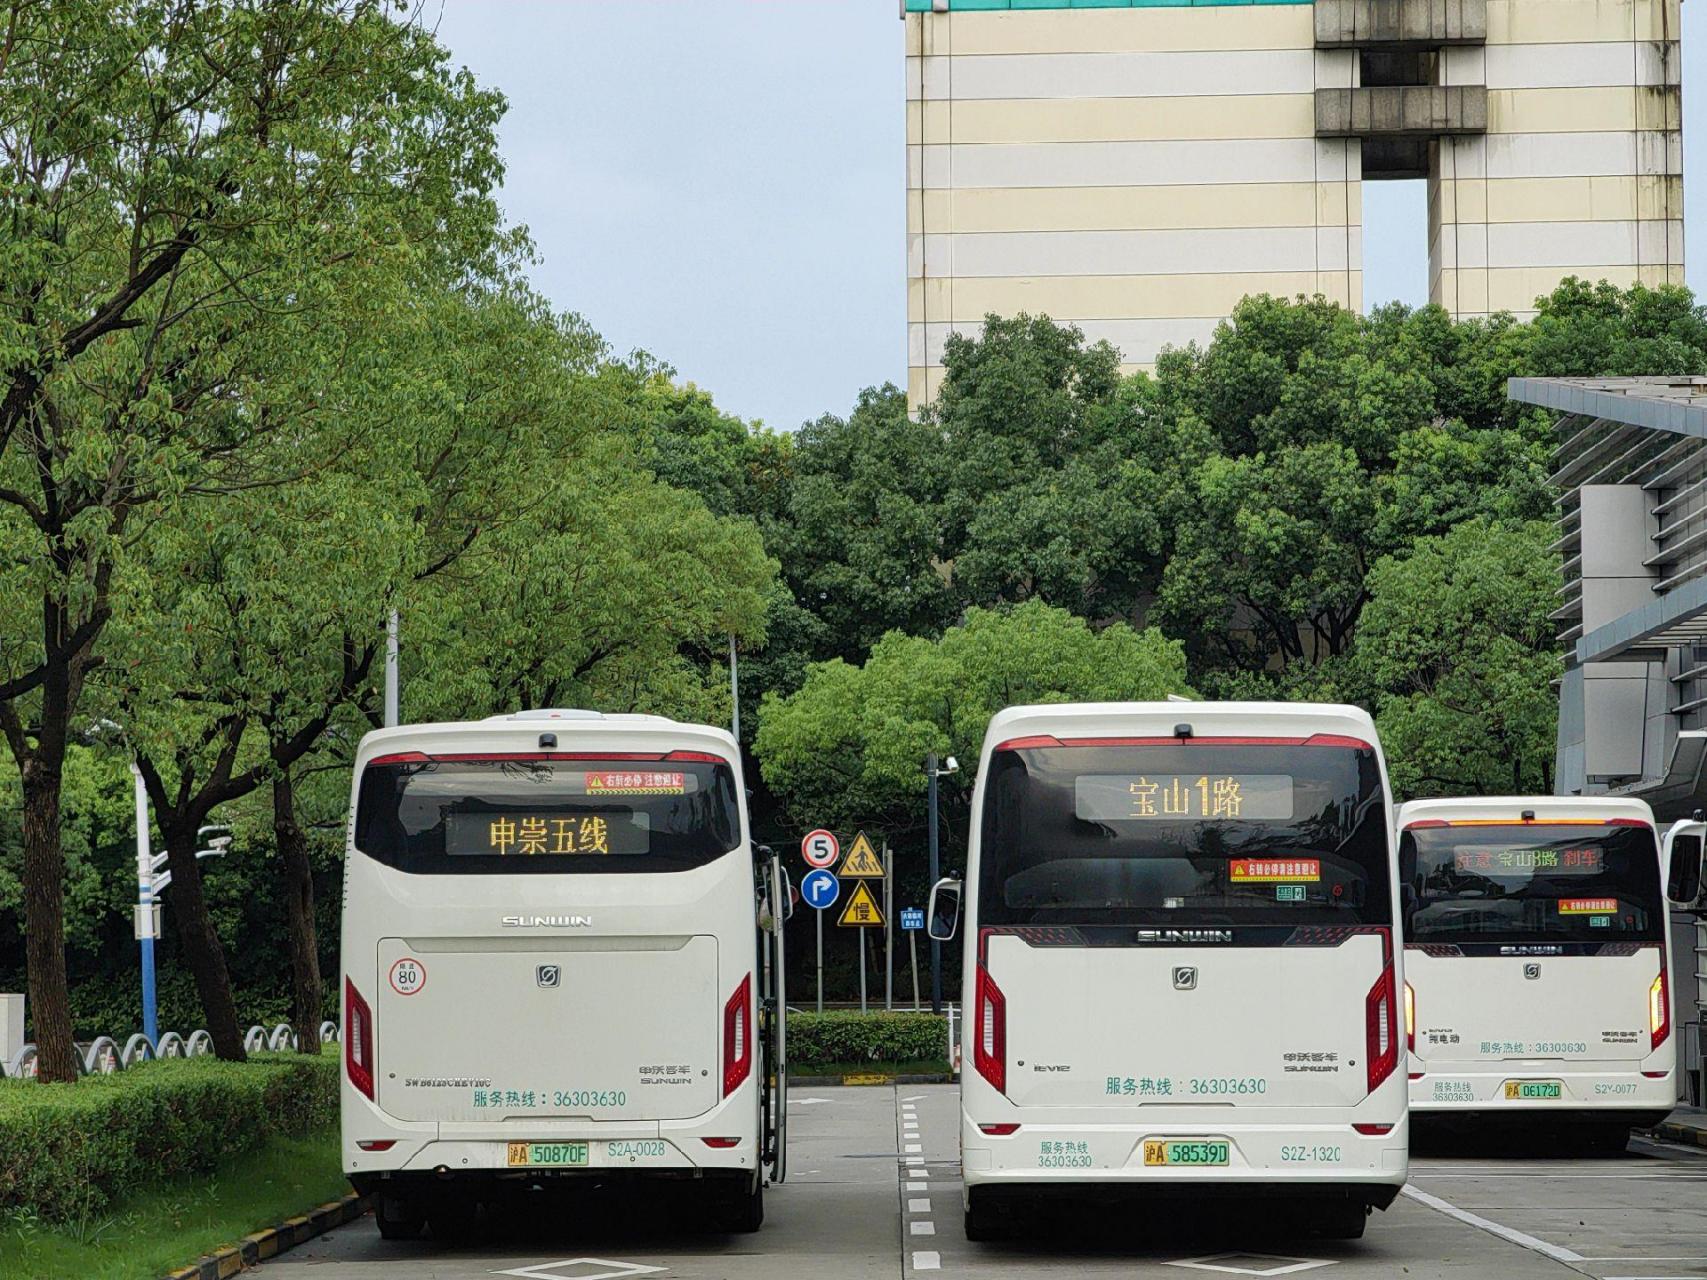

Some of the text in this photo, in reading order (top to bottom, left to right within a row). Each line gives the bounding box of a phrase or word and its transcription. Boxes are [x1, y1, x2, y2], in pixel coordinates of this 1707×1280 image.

[1129, 776, 1243, 817] 宝山1路
[490, 817, 608, 854] 申崇五线
[814, 840, 829, 859] 5
[853, 902, 871, 921] 慢
[501, 916, 593, 927] SUNWIN
[1137, 930, 1232, 942] SUNWIN
[1500, 946, 1563, 955] SUNWIN
[398, 970, 416, 983] 80
[1434, 1082, 1472, 1092] 服务热线
[1595, 1084, 1638, 1095] S2Y-0077
[1432, 1092, 1474, 1102] 36303630
[608, 1142, 665, 1157] S2A-0028
[1040, 1141, 1088, 1155] 服务热线
[1281, 1146, 1341, 1161] S2Z-1320
[1038, 1155, 1092, 1168] 36303630
